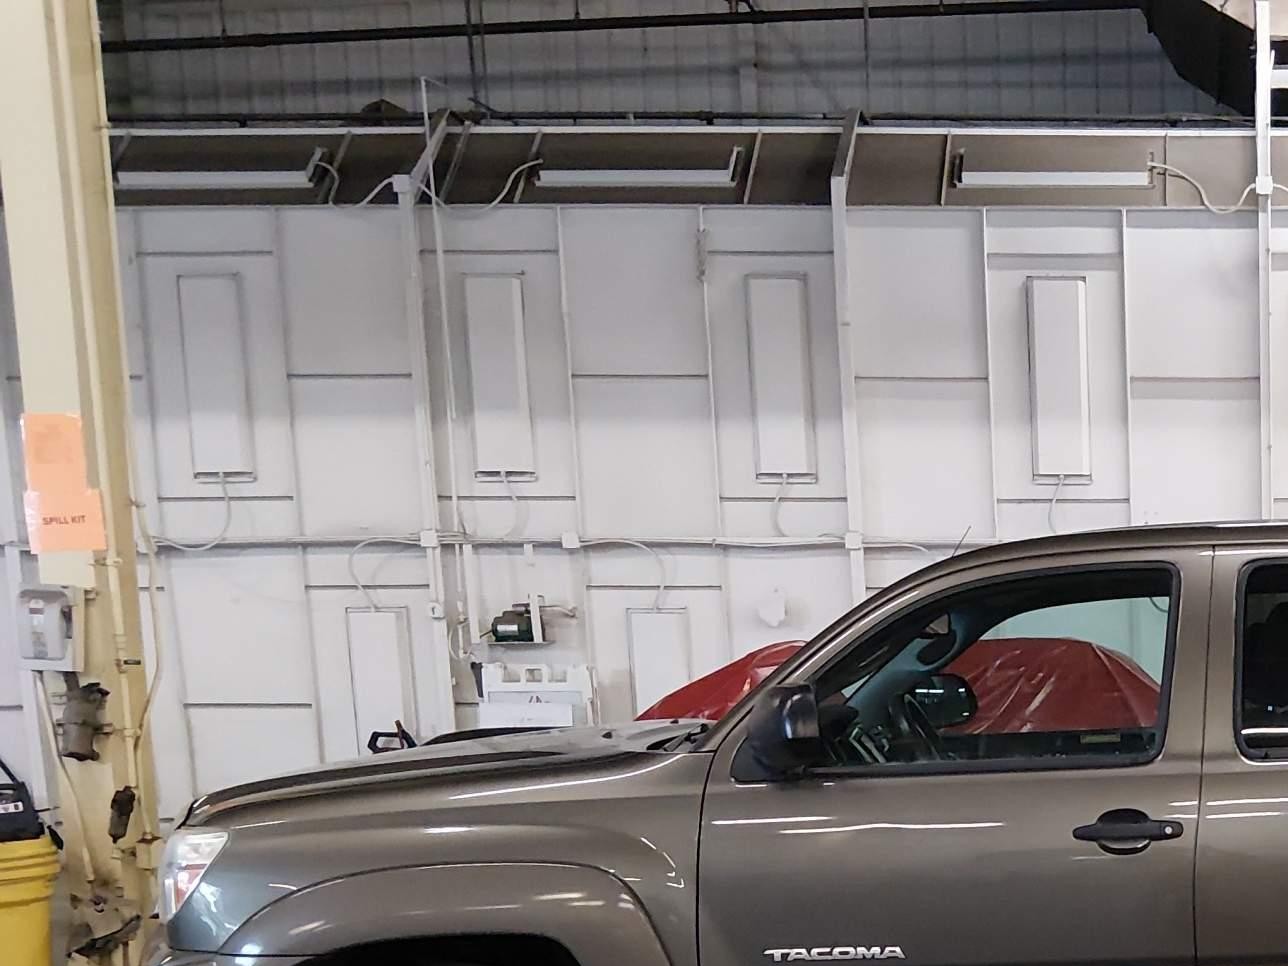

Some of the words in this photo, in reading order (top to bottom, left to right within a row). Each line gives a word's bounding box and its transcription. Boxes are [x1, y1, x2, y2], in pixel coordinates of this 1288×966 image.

[42, 516, 69, 525] SPILL
[71, 515, 86, 524] KIT
[763, 946, 906, 962] TACOMA
